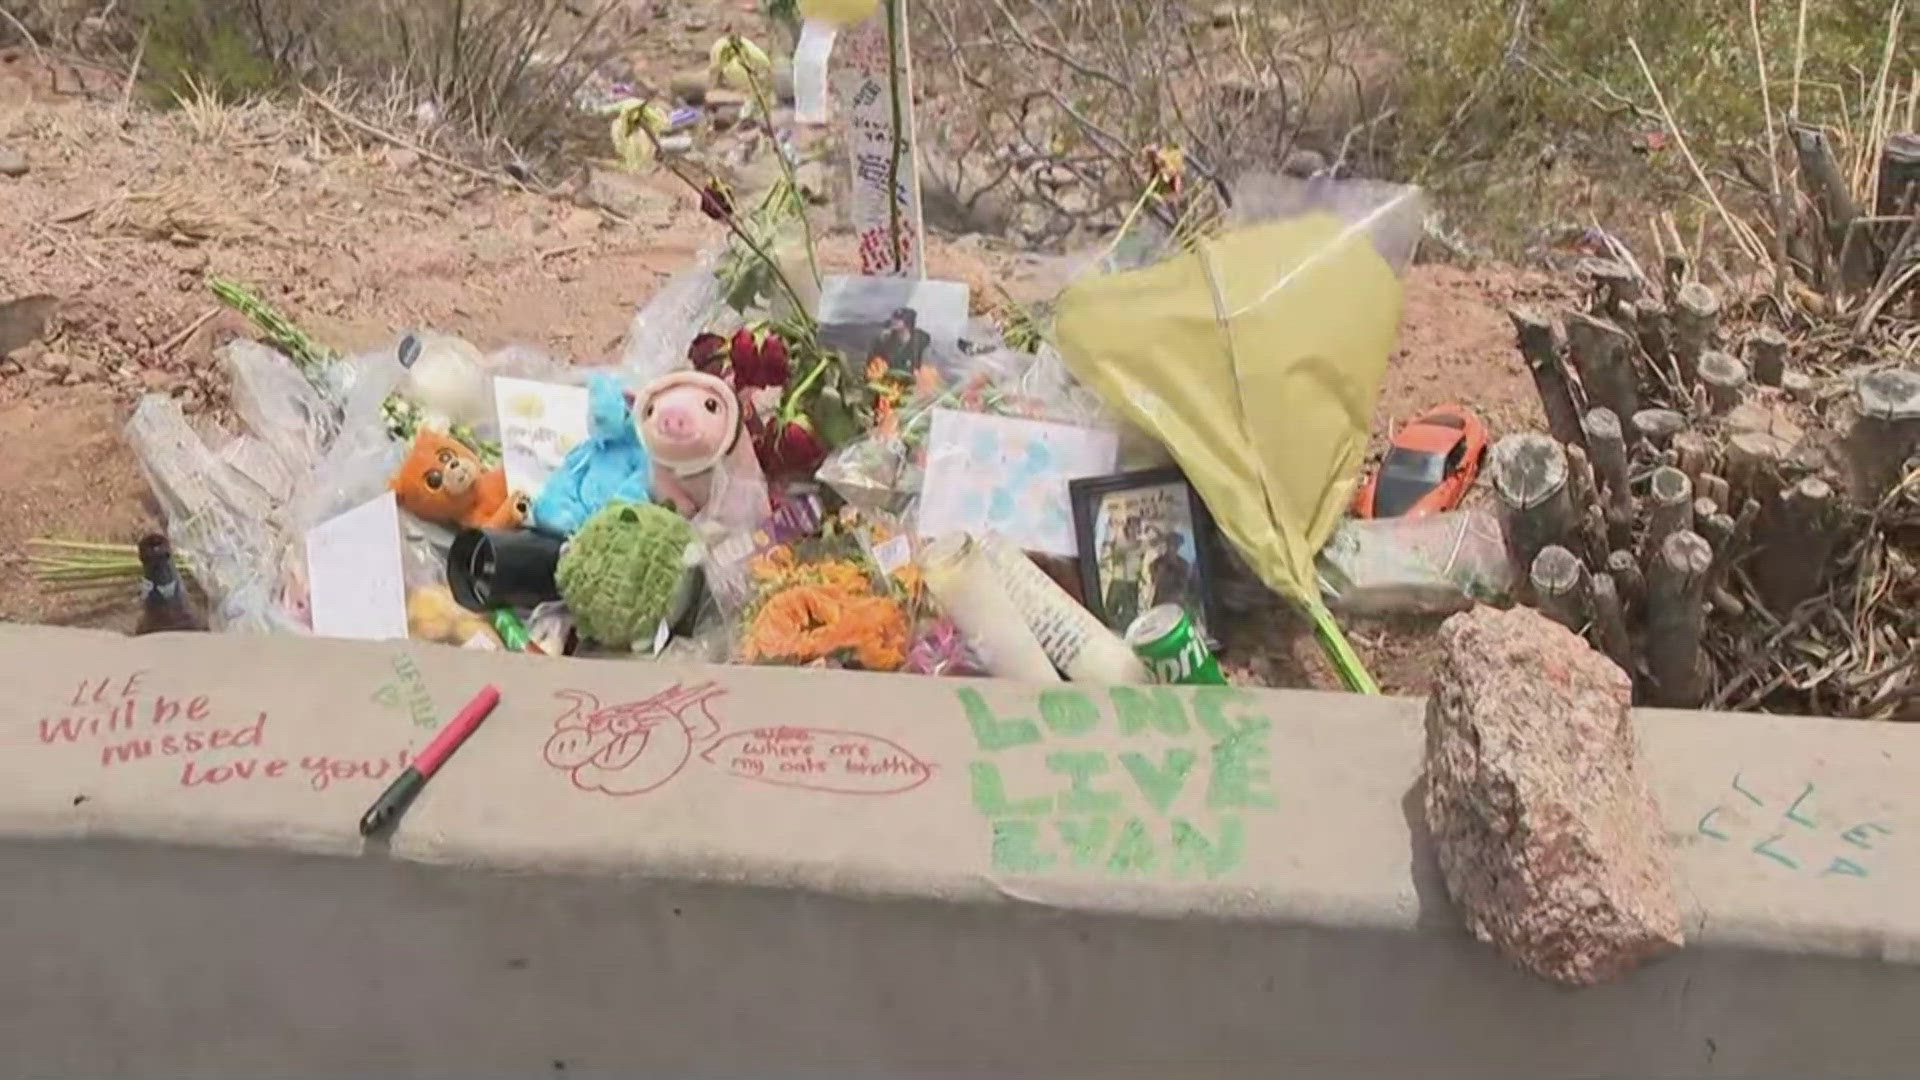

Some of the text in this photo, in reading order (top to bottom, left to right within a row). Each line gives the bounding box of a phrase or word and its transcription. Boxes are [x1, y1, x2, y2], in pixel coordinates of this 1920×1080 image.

[40, 699, 134, 743] Will
[102, 712, 267, 766] missed
[957, 685, 1272, 751] LONG
[731, 757, 765, 775] my
[779, 757, 828, 773] oats
[743, 738, 870, 757] where are
[969, 740, 1279, 816] LIVE
[991, 814, 1244, 880] EVAN
